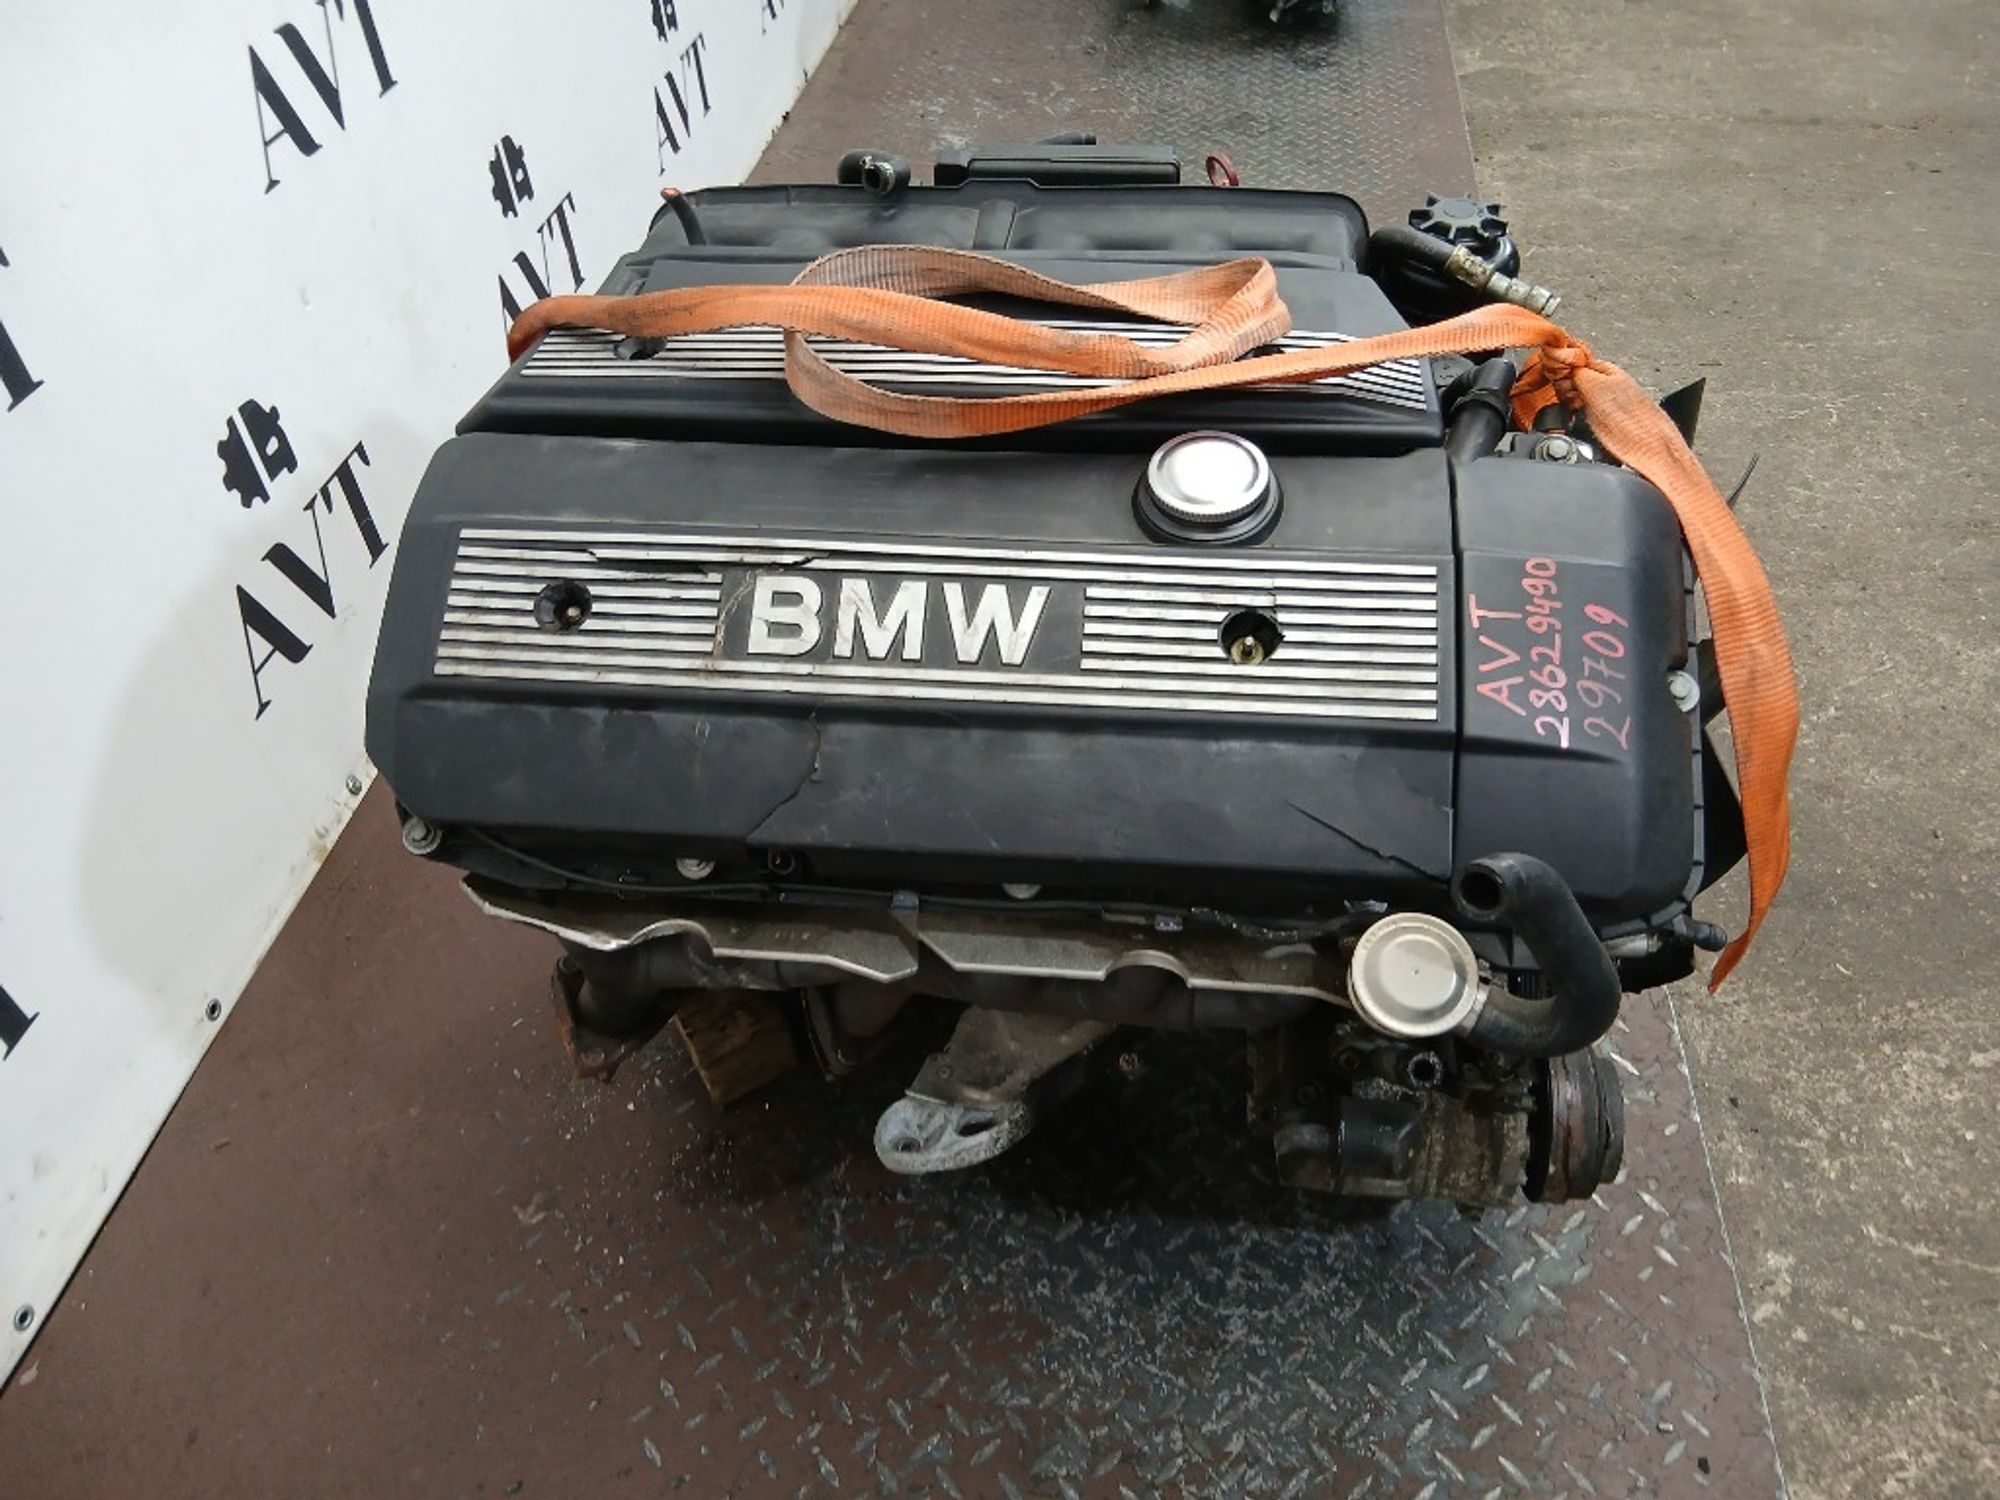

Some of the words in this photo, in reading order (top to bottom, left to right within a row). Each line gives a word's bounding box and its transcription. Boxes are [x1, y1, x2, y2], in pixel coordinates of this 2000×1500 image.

[653, 32, 711, 177] AVT
[236, 441, 389, 720] AVT
[747, 575, 1050, 666] BMW
[1469, 593, 1527, 716] AVT
[1576, 603, 1632, 751] 29709
